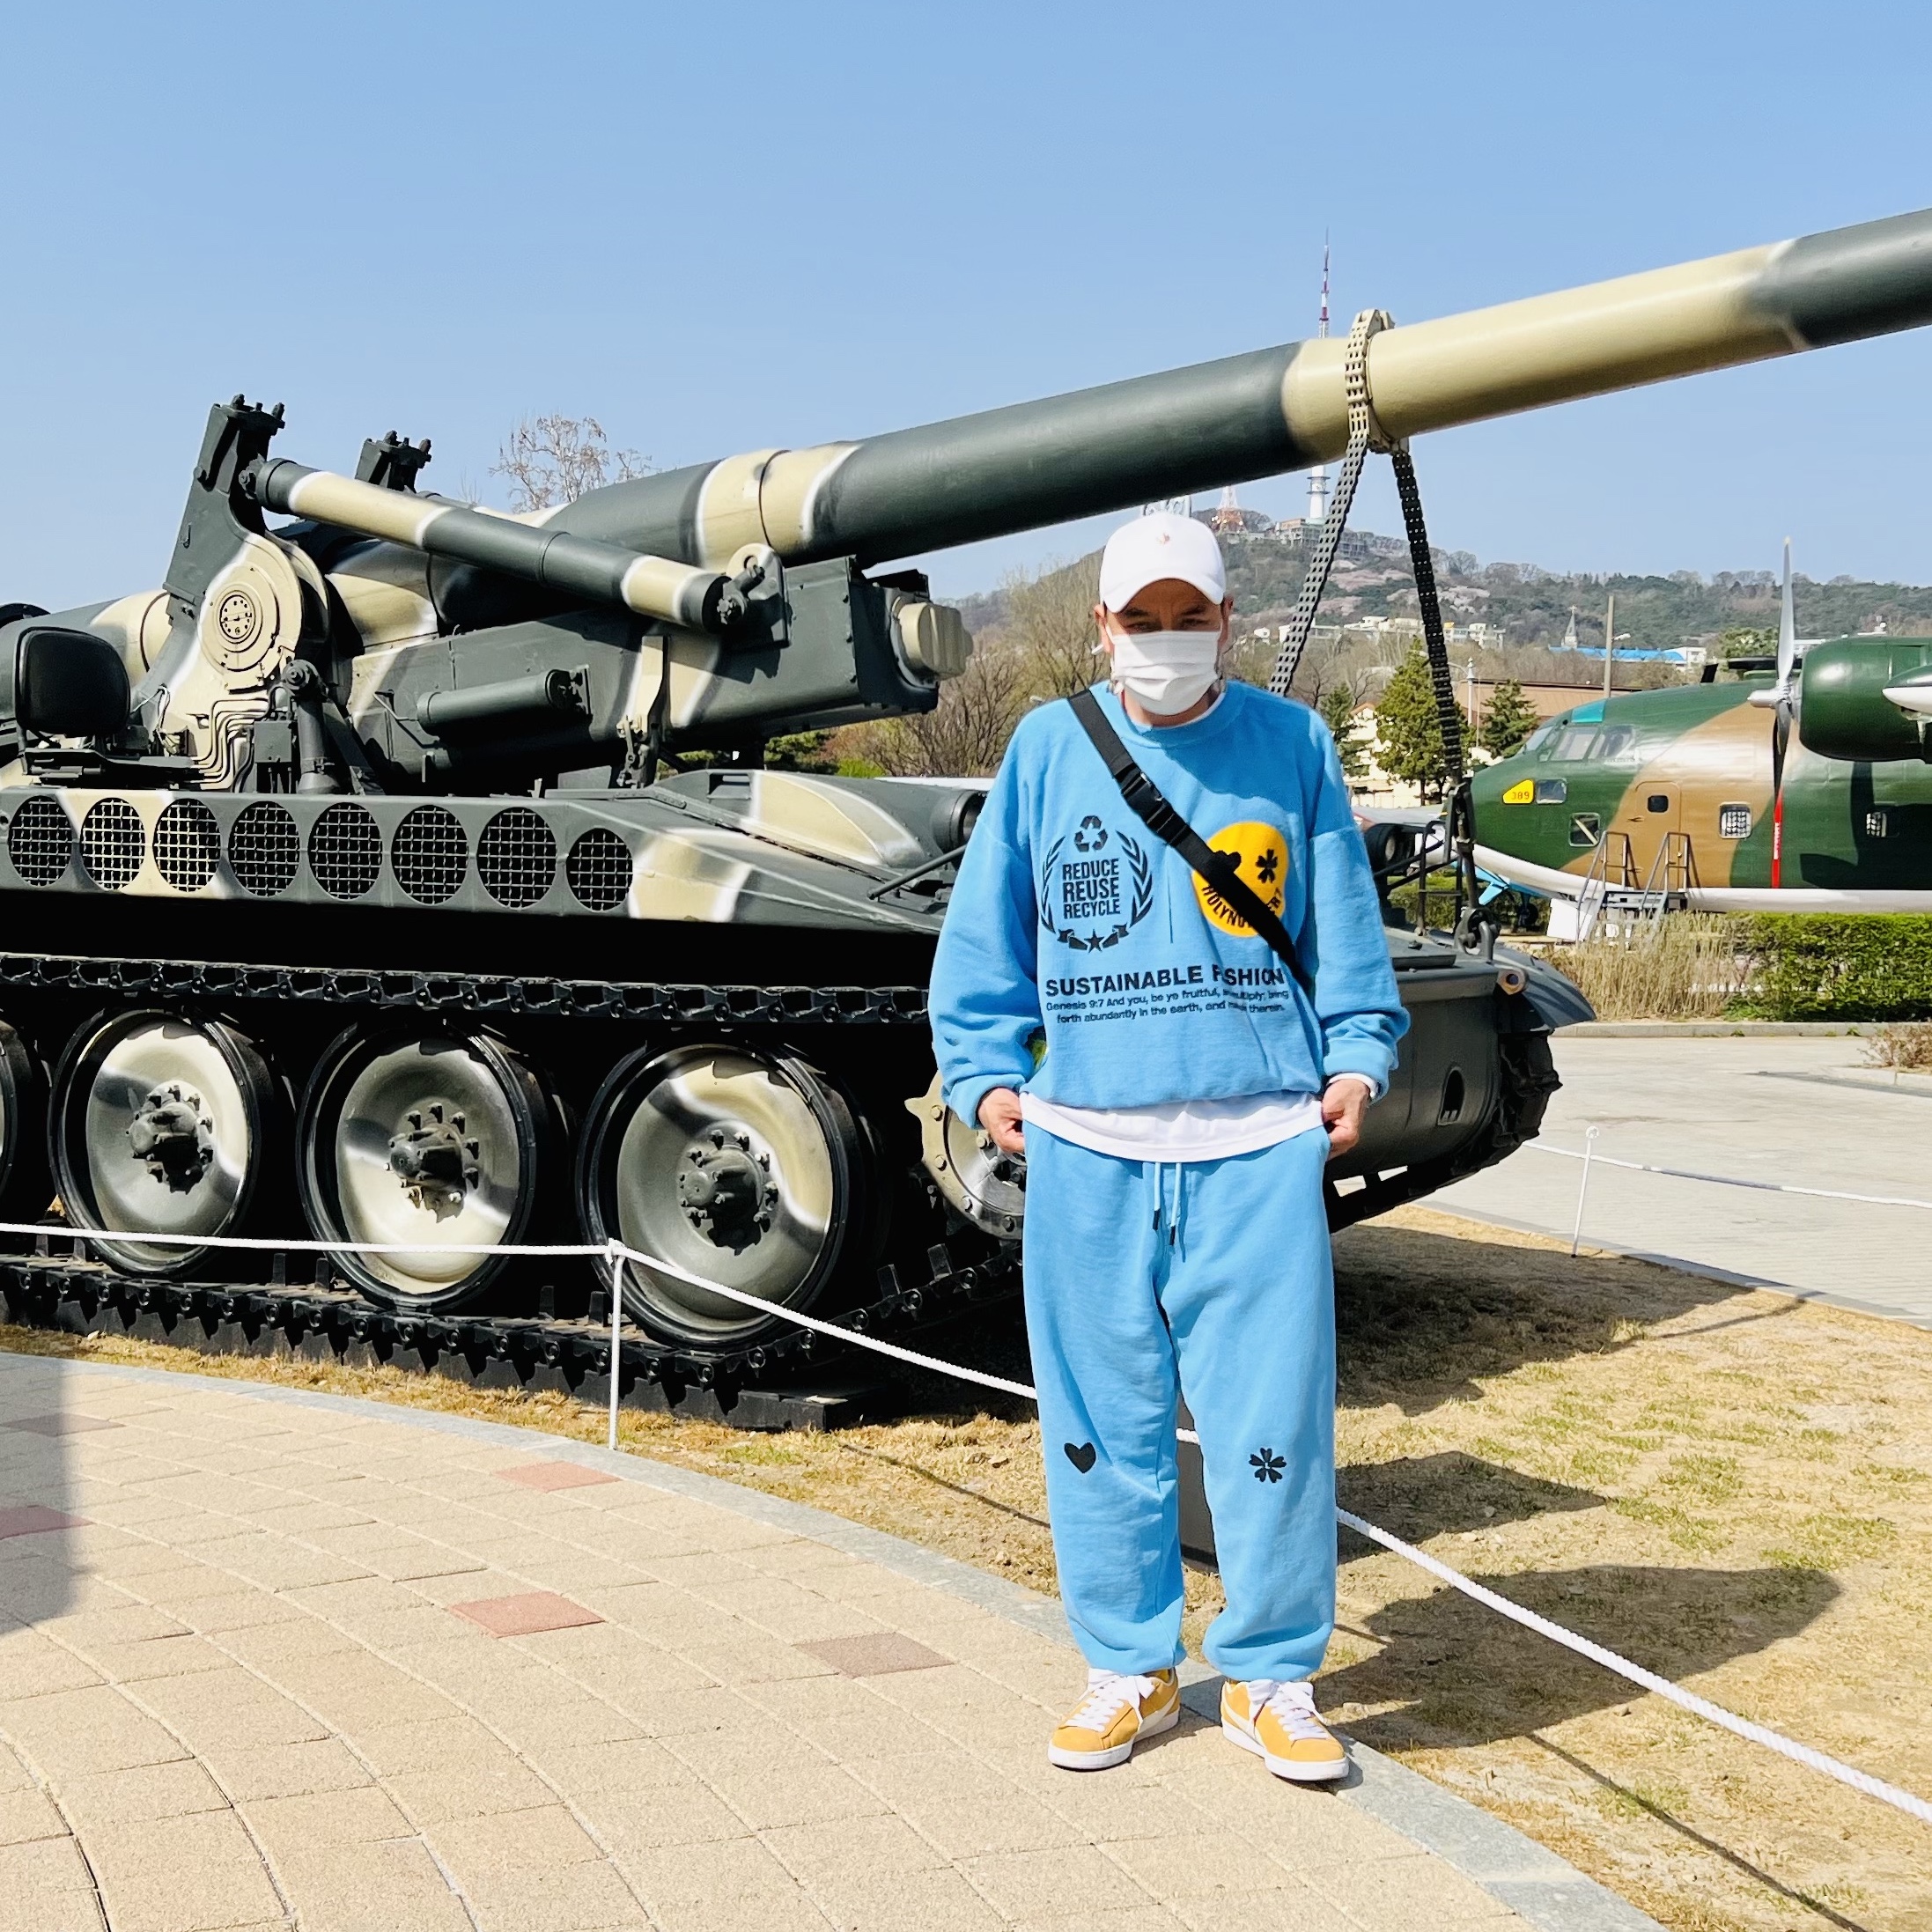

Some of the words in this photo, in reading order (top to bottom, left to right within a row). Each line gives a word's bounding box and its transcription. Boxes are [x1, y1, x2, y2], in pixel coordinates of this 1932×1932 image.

[1062, 858, 1120, 881] REDUCE
[1063, 877, 1120, 903] REUSE
[1064, 898, 1121, 919] RECYCLE
[1045, 965, 1204, 997] SUSTAINABLE
[1212, 964, 1285, 985] FSHION
[1046, 1000, 1086, 1011] Genesis
[1088, 999, 1104, 1008] 9:7
[1107, 997, 1125, 1007] And
[1151, 993, 1163, 1002] be
[1057, 1013, 1081, 1023] forth
[1084, 1008, 1137, 1021] abundantly
[1139, 1007, 1147, 1016] in
[1151, 1006, 1167, 1015] the
[1206, 1000, 1226, 1010] and
